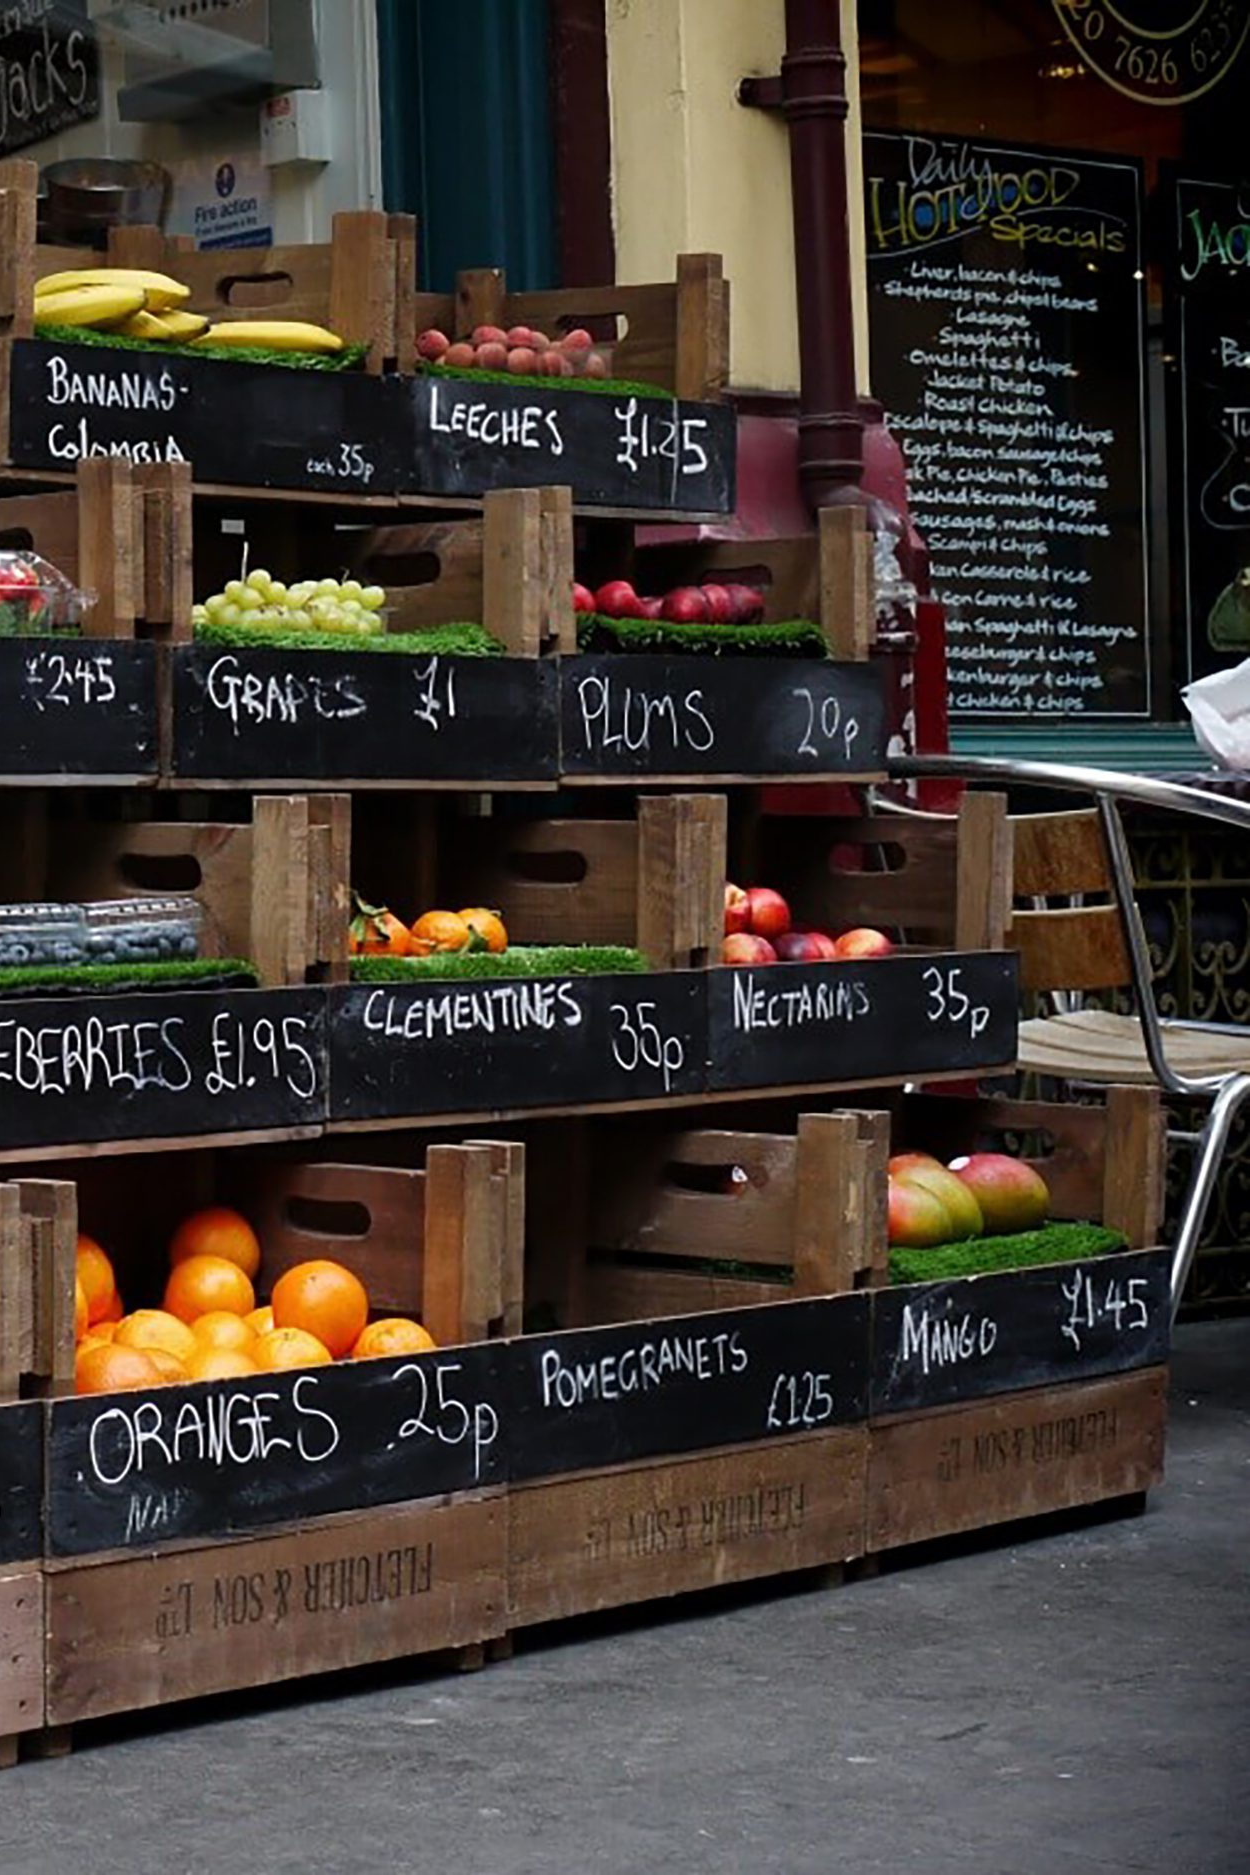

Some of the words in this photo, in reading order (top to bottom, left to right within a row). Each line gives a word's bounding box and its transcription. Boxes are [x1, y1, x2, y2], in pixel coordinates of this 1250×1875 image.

[1113, 35, 1178, 85] 7626
[220, 197, 258, 218] action
[869, 177, 967, 248] HOT
[990, 214, 1126, 252] Specials
[1018, 270, 1063, 291] chips
[909, 350, 1013, 371] Omelettes
[938, 326, 1041, 352] Spaghetti
[923, 391, 975, 411] Roast
[926, 370, 986, 390] Jacket
[989, 375, 1046, 396] Potato
[430, 386, 563, 455] LEECHES
[338, 442, 375, 485] 35p
[412, 655, 457, 730] £1
[578, 675, 715, 753] PLUMS
[792, 687, 860, 760] 20p
[921, 966, 990, 1039] 35p
[205, 1012, 317, 1099] £1.95
[362, 981, 583, 1039] CLEMENTINES
[609, 1002, 684, 1092] 35p
[902, 1304, 998, 1375] MANGO
[1061, 1268, 1149, 1351] £1.45
[541, 1332, 748, 1408] POMEGRANETS
[89, 1376, 340, 1484] ORANGES
[391, 1363, 498, 1480] 25p
[213, 1574, 267, 1631] SON
[273, 1569, 292, 1622] &
[305, 1541, 433, 1614] FLETCHER
